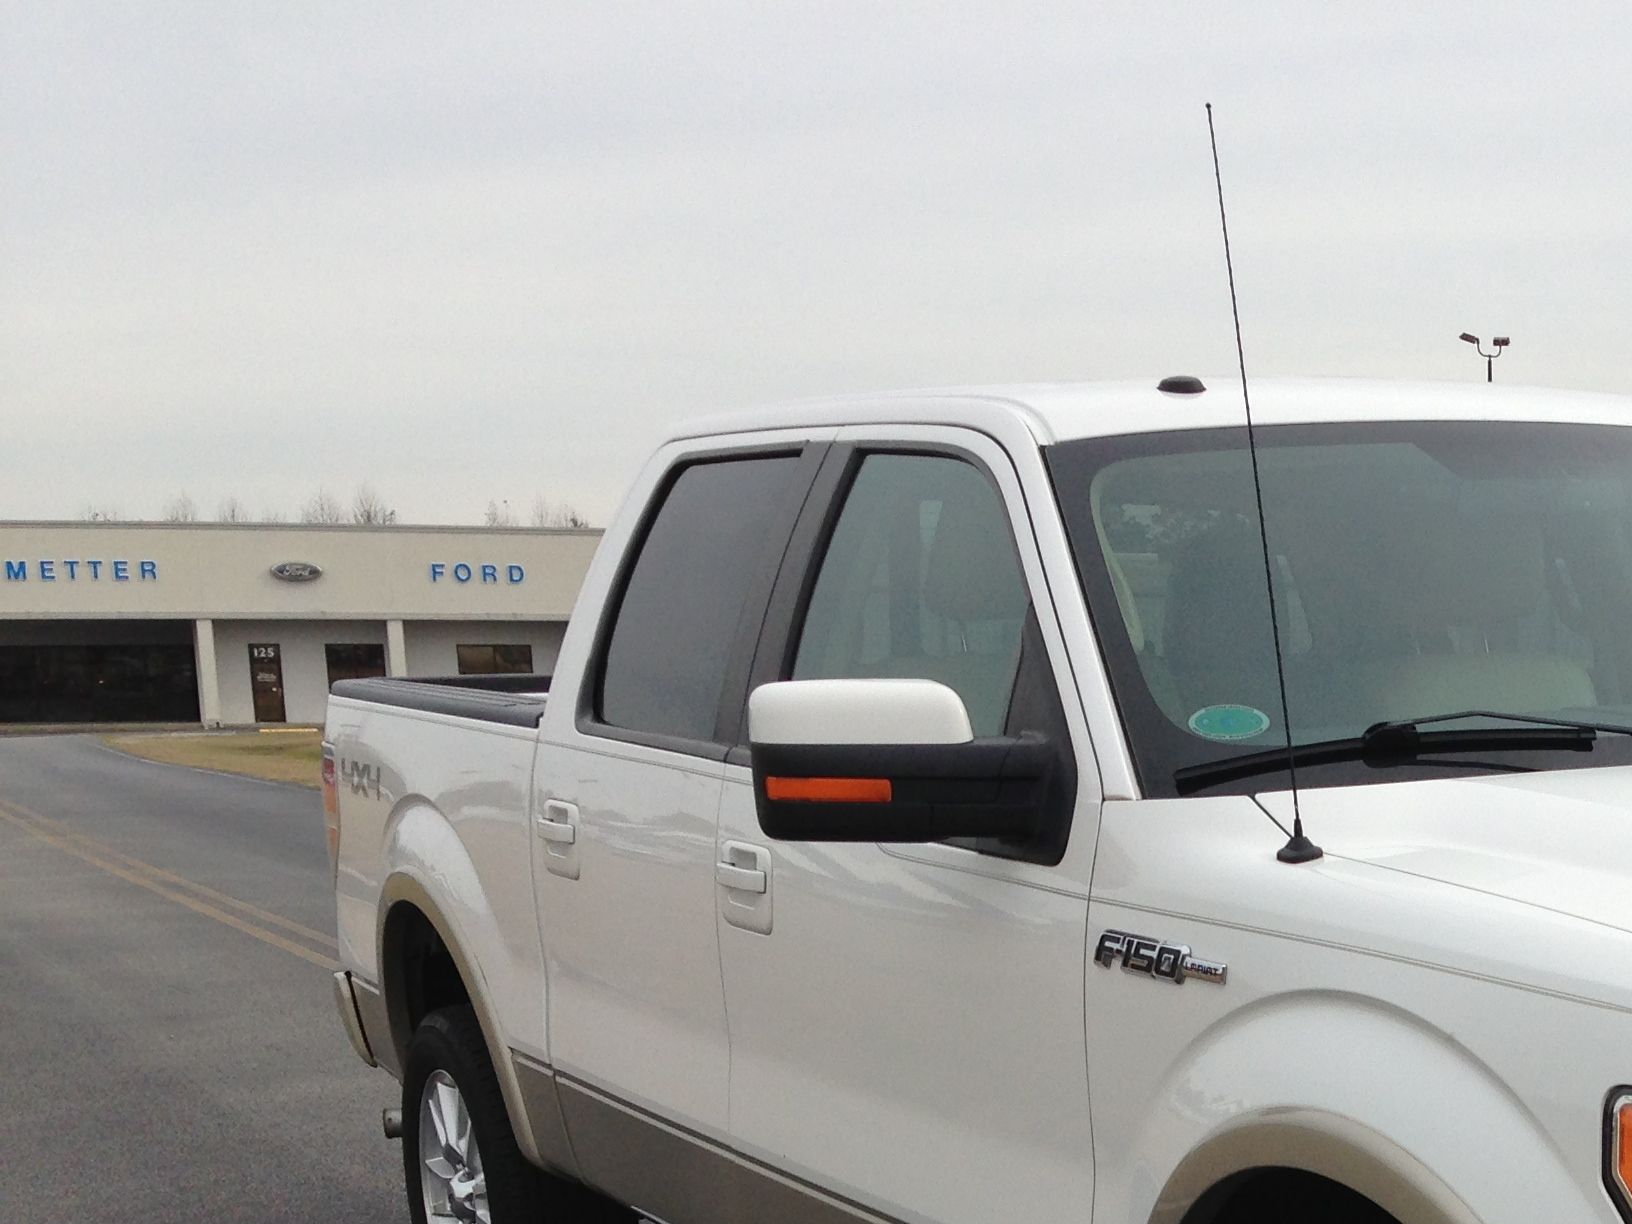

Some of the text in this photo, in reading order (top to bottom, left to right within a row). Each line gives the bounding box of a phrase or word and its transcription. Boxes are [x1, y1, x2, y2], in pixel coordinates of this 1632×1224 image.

[5, 560, 158, 581] METTER
[431, 563, 525, 583] FORD
[252, 647, 275, 658] 125
